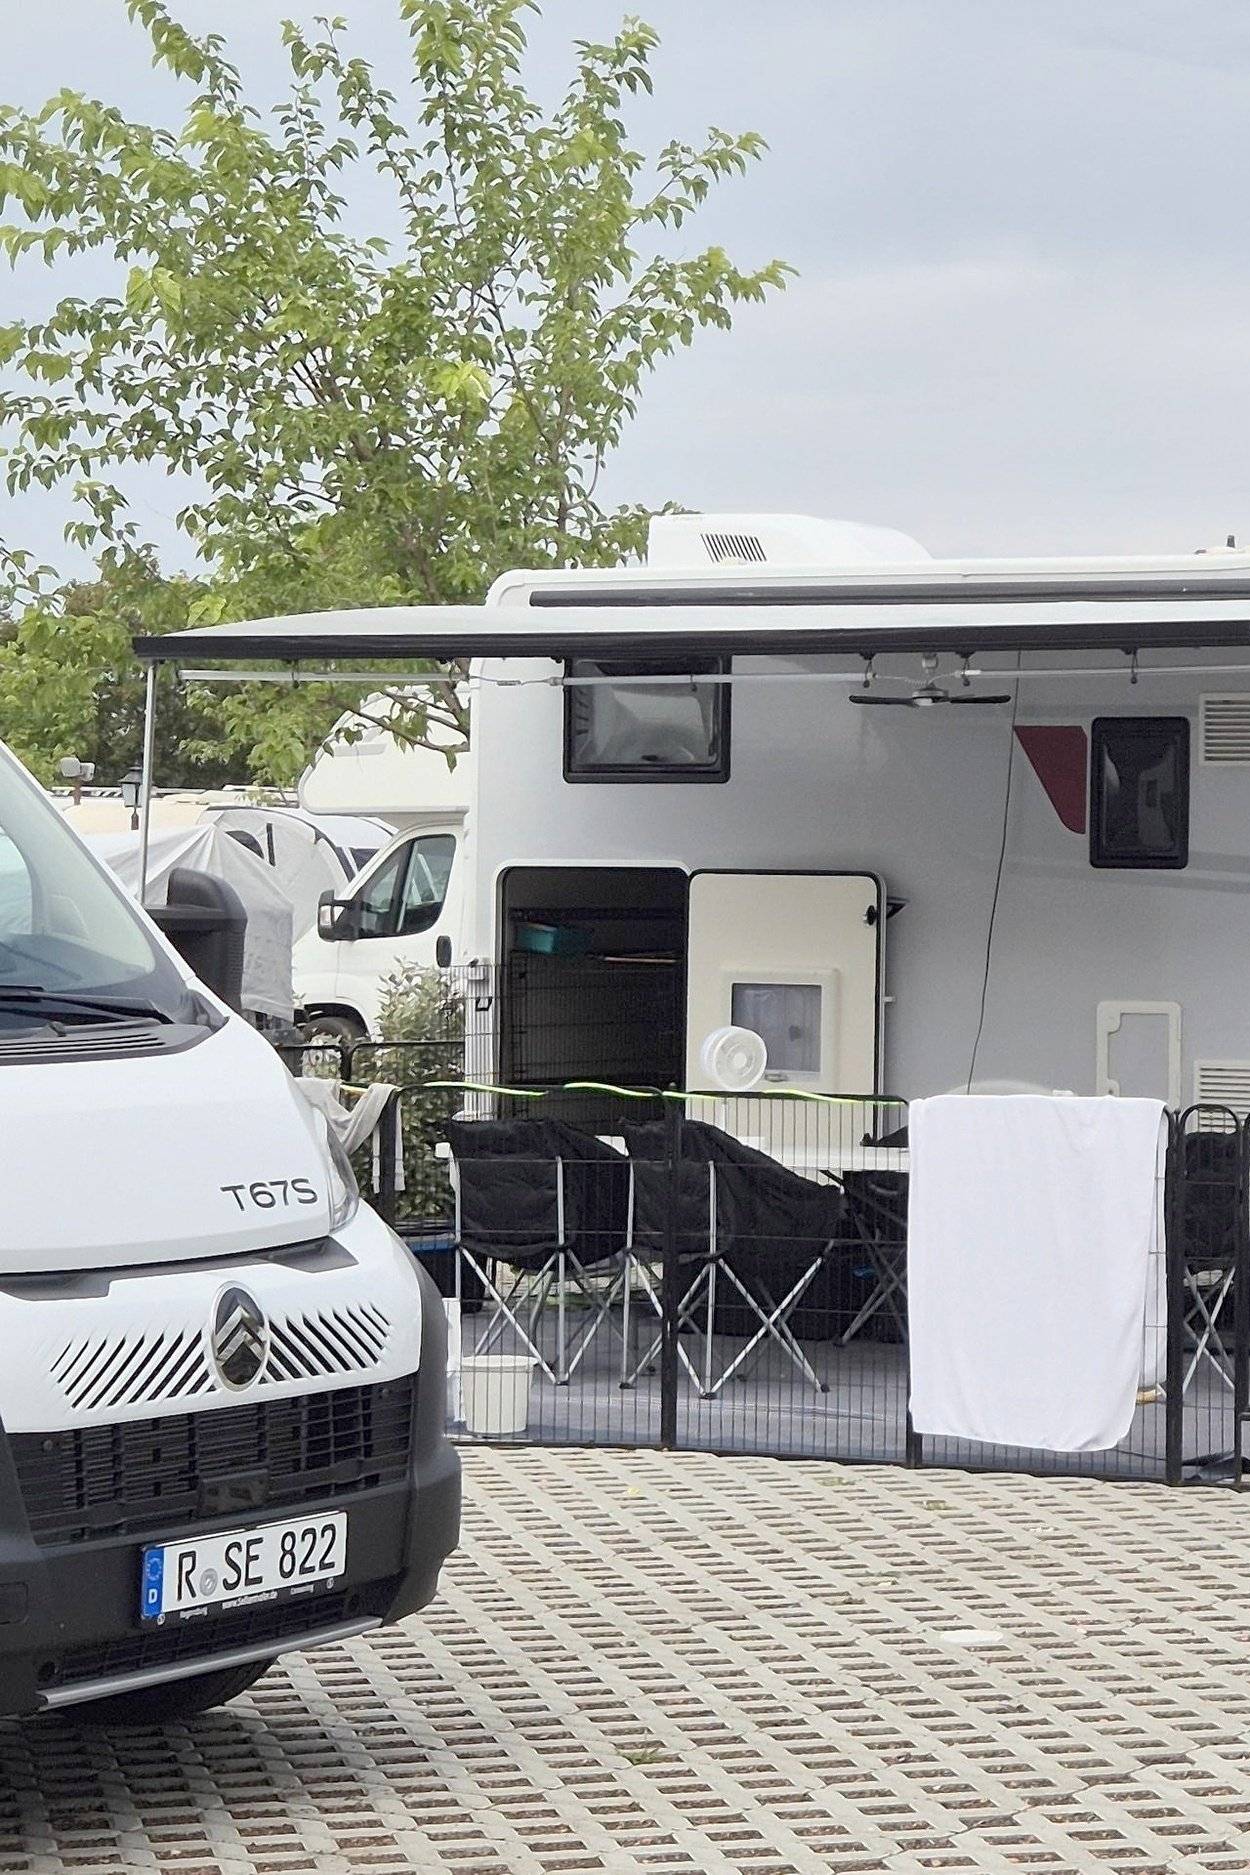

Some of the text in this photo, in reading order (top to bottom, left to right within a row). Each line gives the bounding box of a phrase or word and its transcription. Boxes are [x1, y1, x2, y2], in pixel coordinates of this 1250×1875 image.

[220, 1178, 318, 1212] T67S
[177, 1523, 337, 1601] R SE 822
[148, 1588, 158, 1604] D
